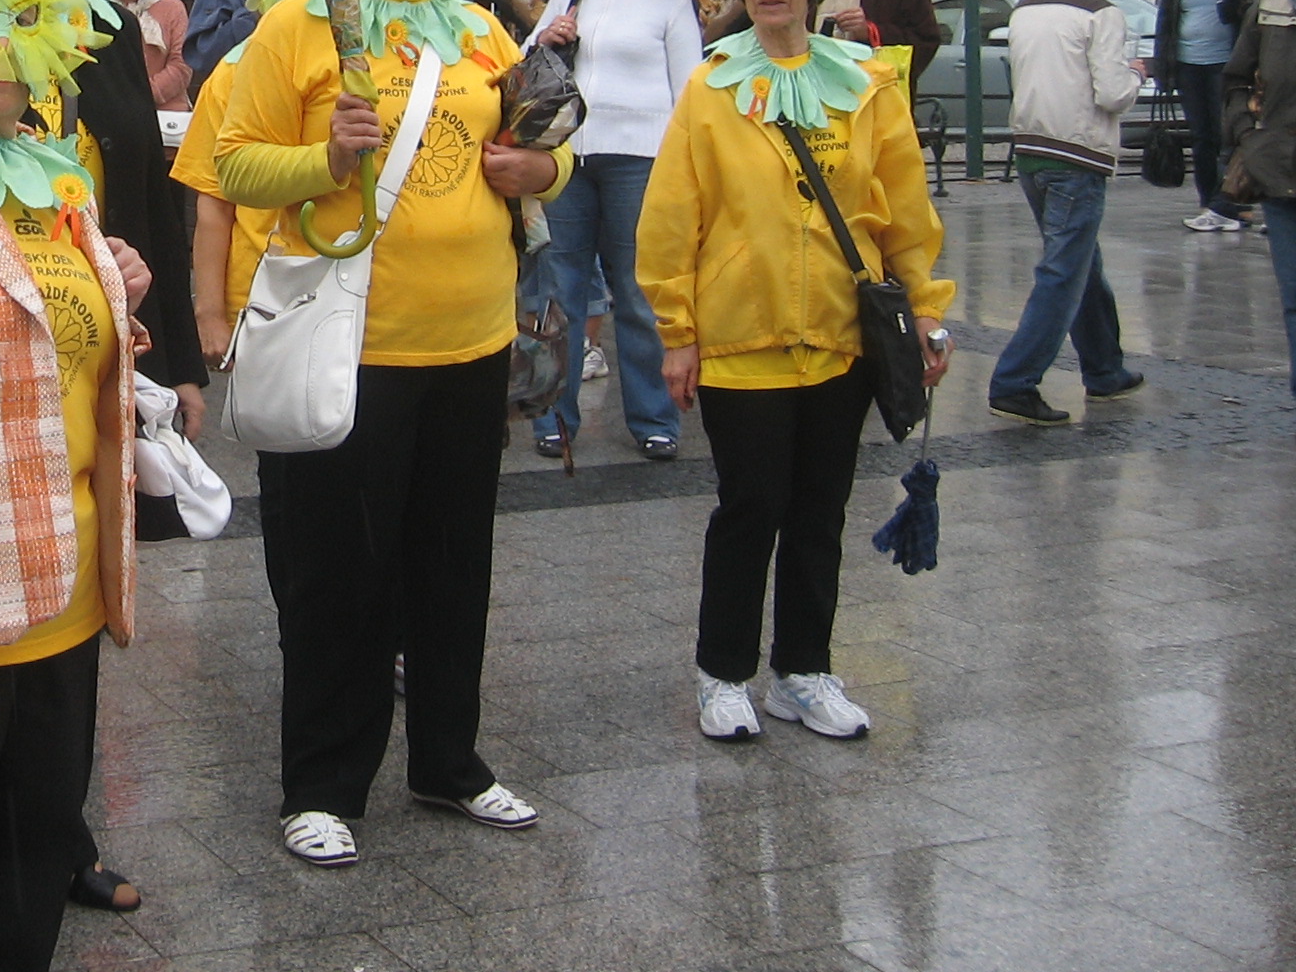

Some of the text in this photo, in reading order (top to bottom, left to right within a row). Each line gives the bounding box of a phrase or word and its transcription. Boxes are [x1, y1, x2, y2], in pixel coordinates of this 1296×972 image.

[378, 89, 408, 97] PROTI
[815, 132, 835, 141] DEN
[52, 254, 75, 266] DEN
[70, 295, 100, 348] RODINĚ
